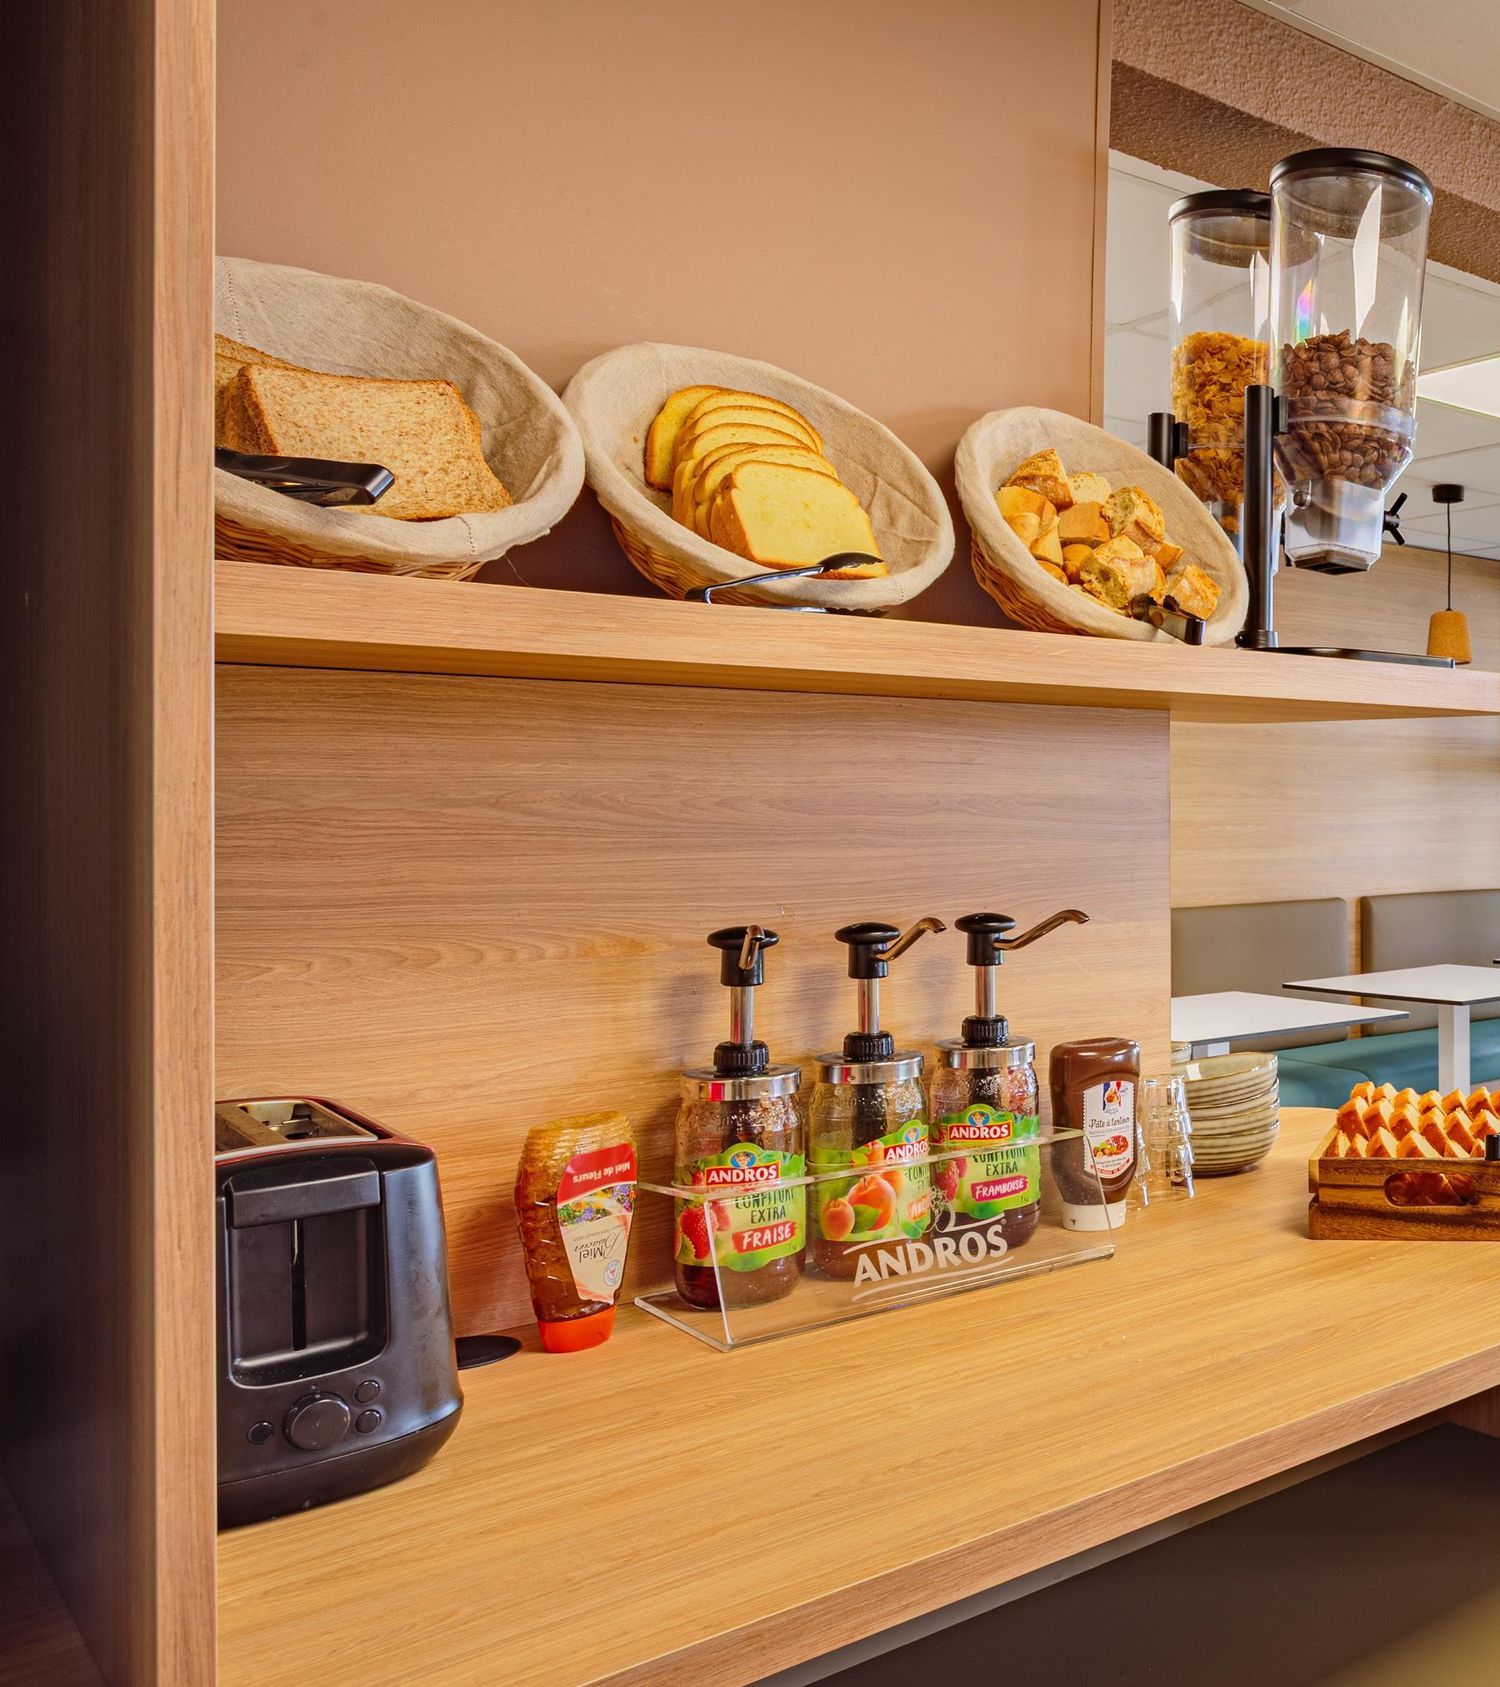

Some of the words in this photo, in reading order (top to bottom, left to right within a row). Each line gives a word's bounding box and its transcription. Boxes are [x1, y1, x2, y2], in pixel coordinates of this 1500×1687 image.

[950, 1124, 1009, 1139] ANDROS
[885, 1138, 928, 1162] ANDROS
[572, 1170, 602, 1184] Fleurs
[603, 1166, 614, 1177] de
[615, 1161, 631, 1175] Miel
[708, 1165, 777, 1184] ANDROS
[986, 1161, 1018, 1177] EXTRA
[975, 1177, 1024, 1200] FRAMBOISE
[751, 1206, 787, 1224] EXTRA
[742, 1222, 793, 1251] FRAISE
[579, 1245, 603, 1263] Miel
[853, 1224, 1008, 1289] ANDROS
